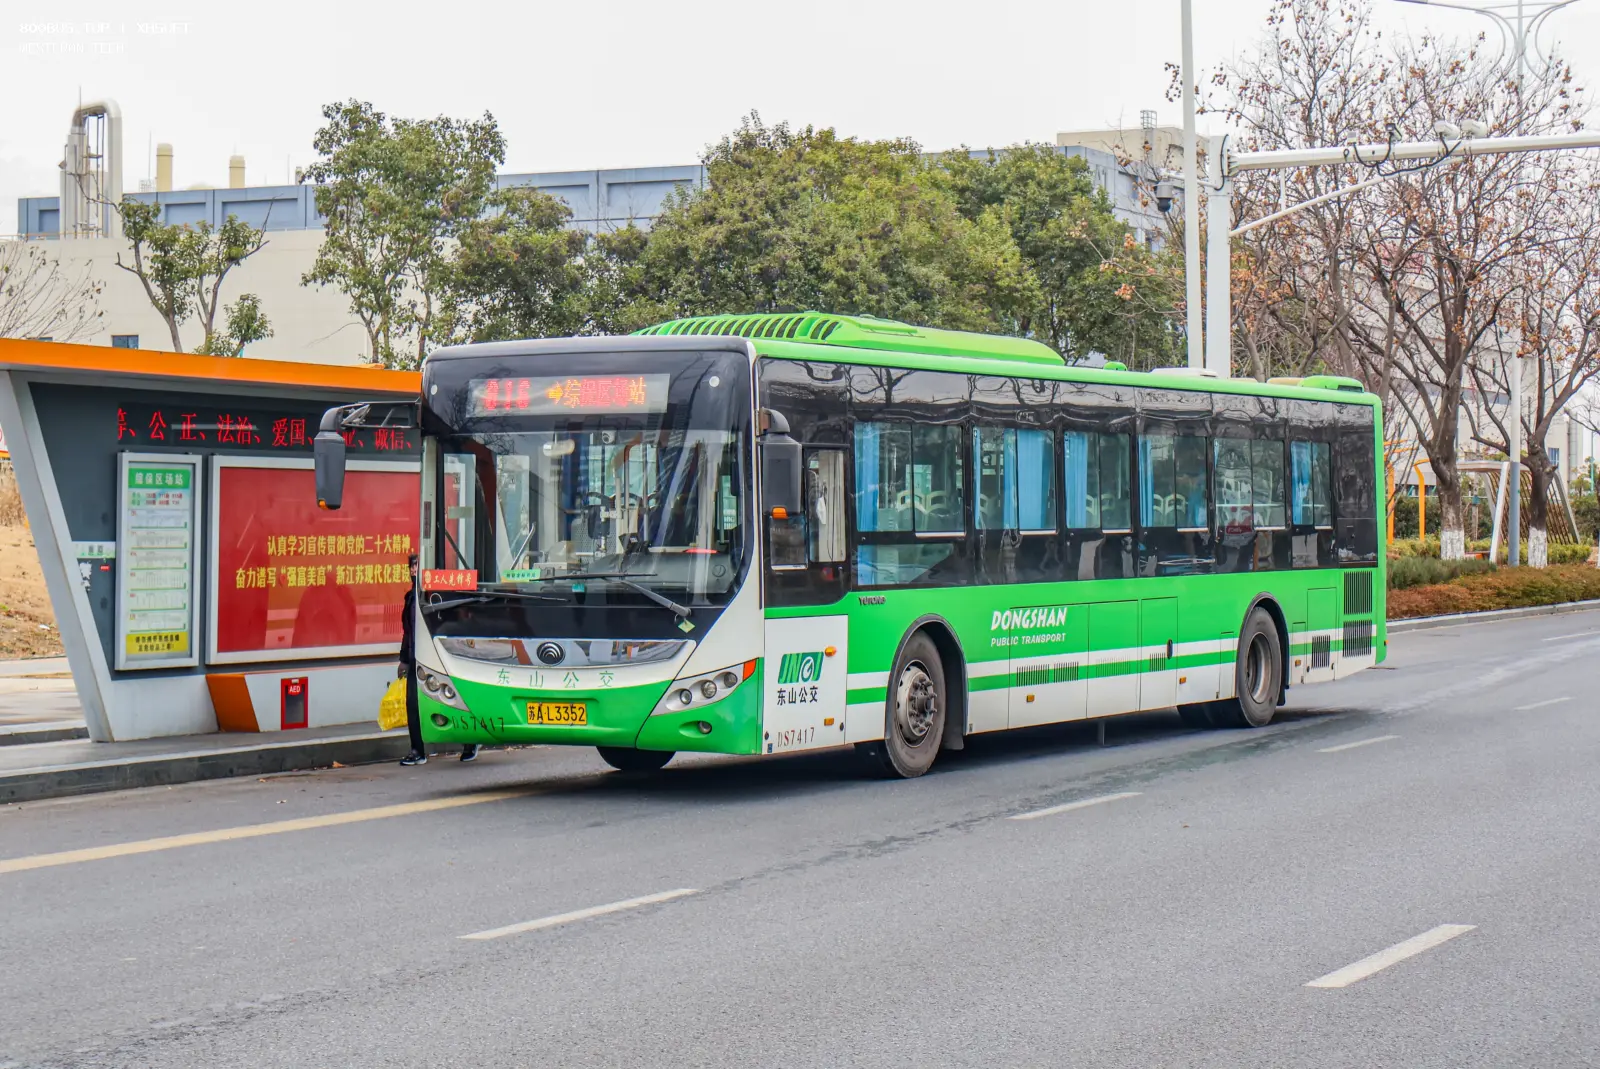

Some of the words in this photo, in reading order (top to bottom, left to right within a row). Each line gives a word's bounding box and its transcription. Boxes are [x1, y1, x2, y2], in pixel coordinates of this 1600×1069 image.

[990, 607, 1068, 631] DONGSHAN
[990, 635, 1019, 647] PUBLIC
[1021, 632, 1067, 645] TRANSPORT
[290, 685, 301, 693] AED
[497, 668, 615, 689] 东山公交
[777, 685, 819, 706] 东山公交
[452, 715, 505, 733] DS7417
[777, 726, 815, 748] DS7417
